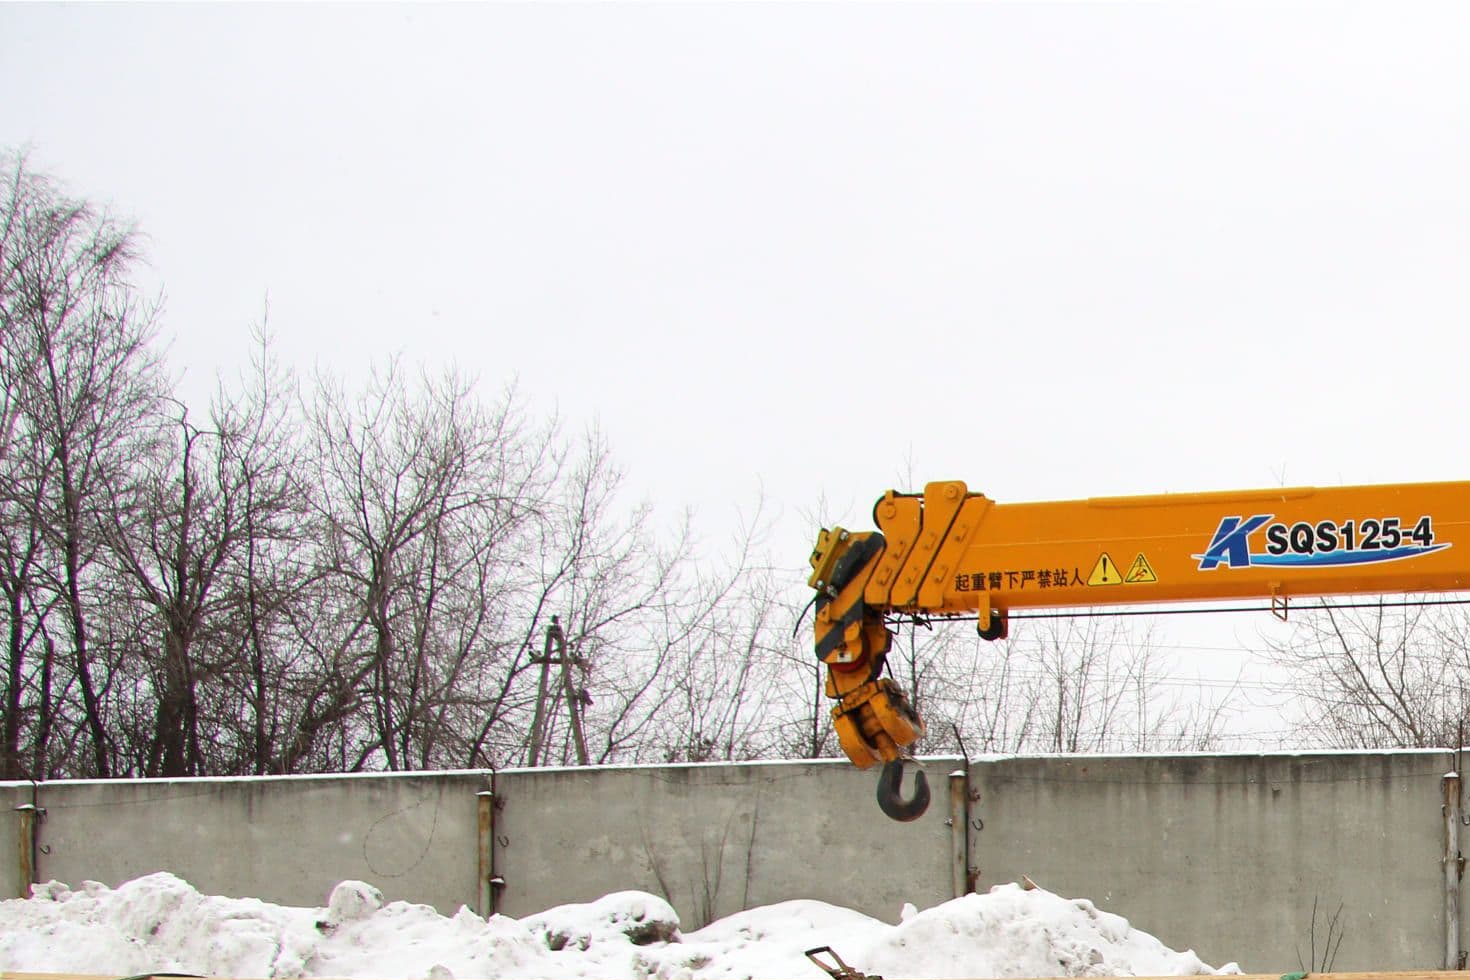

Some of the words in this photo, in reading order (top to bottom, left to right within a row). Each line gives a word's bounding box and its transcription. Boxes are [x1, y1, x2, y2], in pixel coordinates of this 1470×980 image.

[1266, 517, 1433, 555] SQS125-4
[955, 568, 1084, 592] 起重臂下严禁站人
